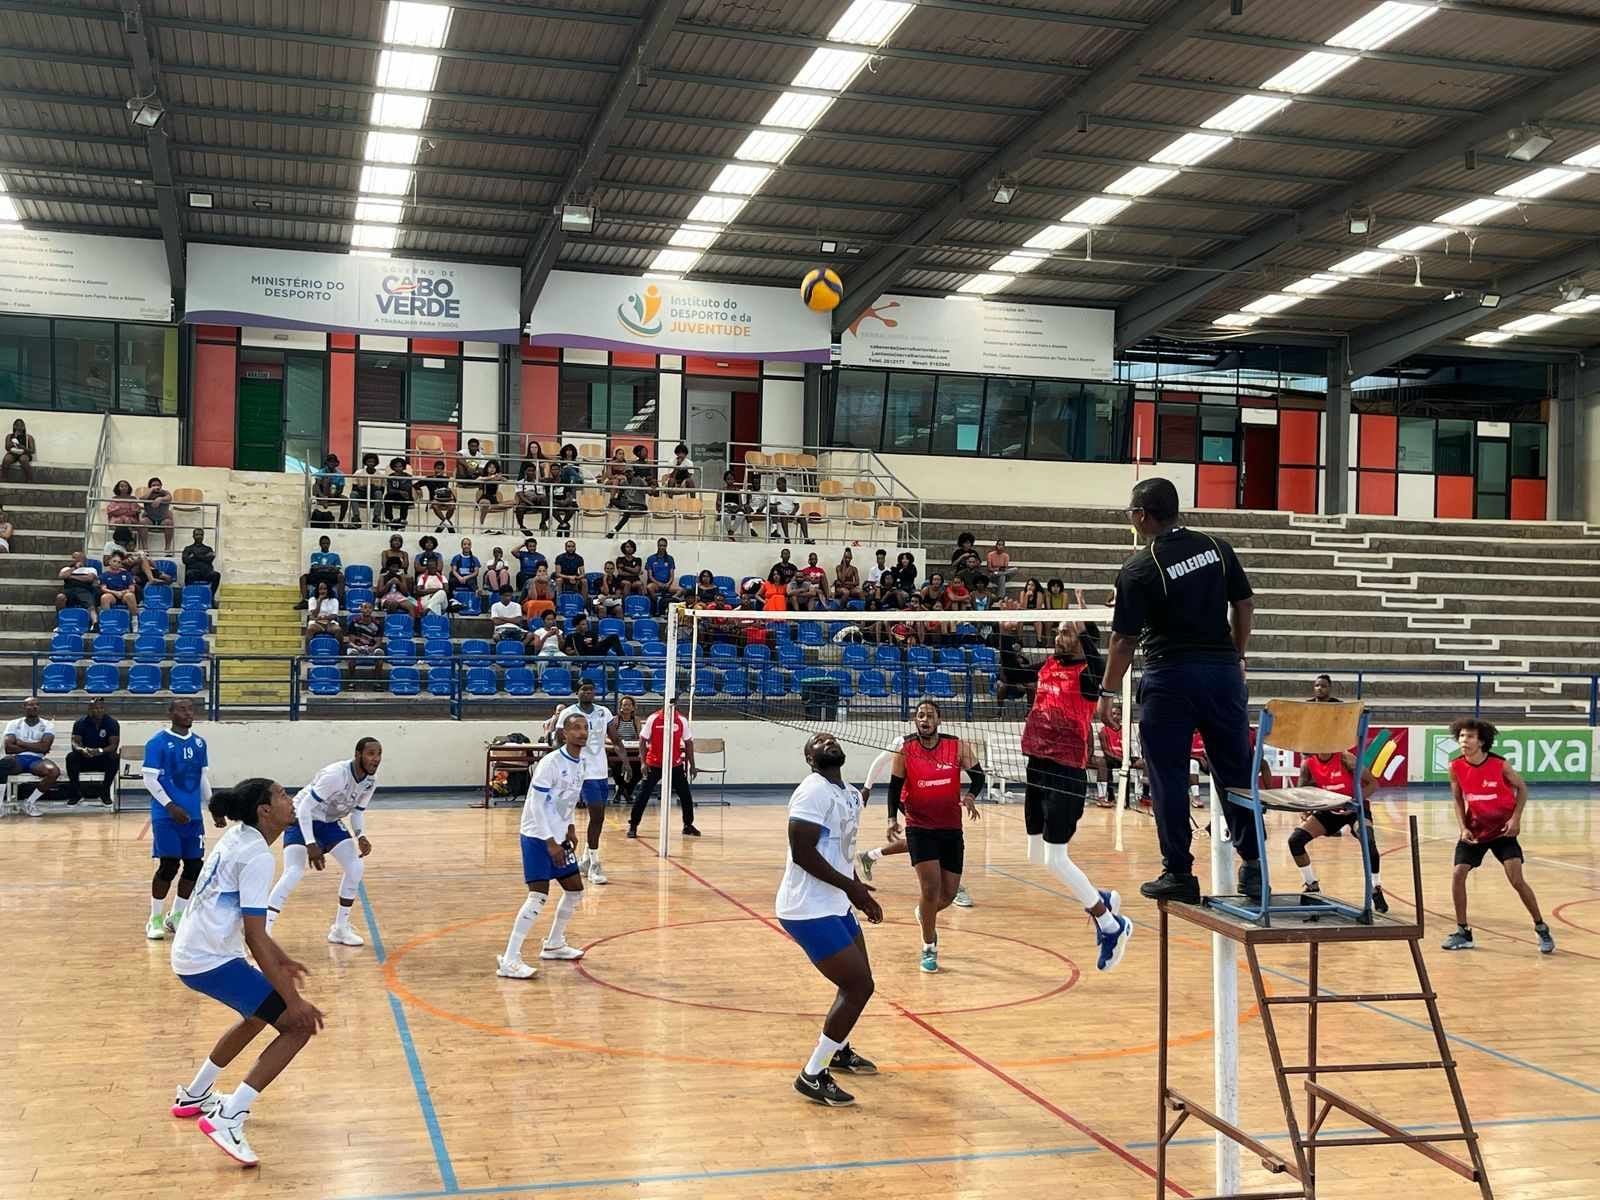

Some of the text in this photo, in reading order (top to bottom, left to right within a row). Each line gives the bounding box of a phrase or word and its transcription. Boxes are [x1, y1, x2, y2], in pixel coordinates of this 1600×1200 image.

[251, 275, 345, 291] MINISTÉRIO DO
[382, 275, 454, 298] CABO
[264, 288, 332, 301] DESPORTO
[671, 296, 737, 309] Instituto do
[375, 294, 460, 318] VERDE
[670, 309, 752, 322] DESPORTO e da
[670, 321, 752, 337] JUVENTUDE
[1166, 549, 1220, 580] VOLEIBOL
[183, 746, 194, 760] 19
[1493, 739, 1587, 772] aixa
